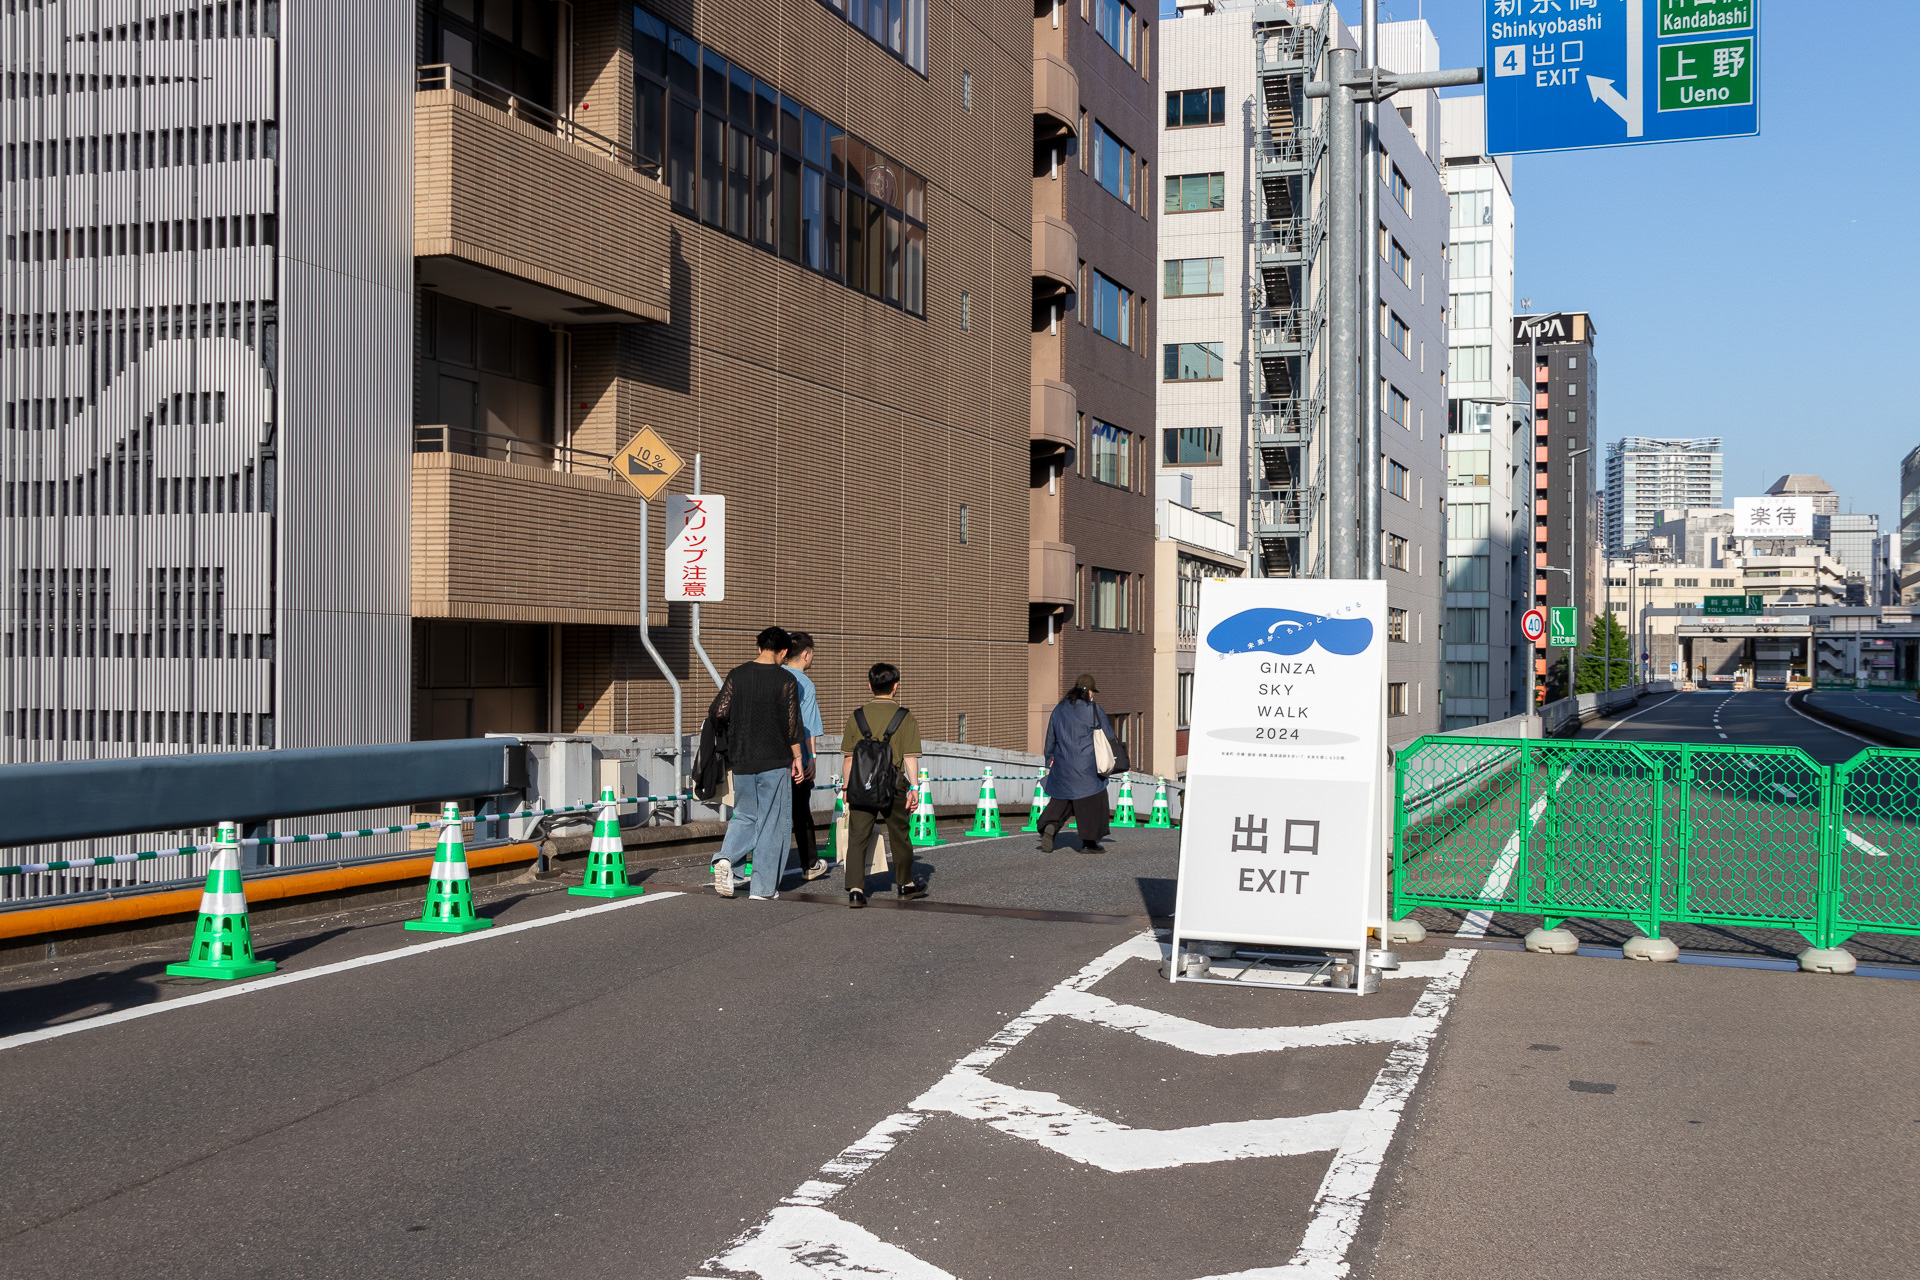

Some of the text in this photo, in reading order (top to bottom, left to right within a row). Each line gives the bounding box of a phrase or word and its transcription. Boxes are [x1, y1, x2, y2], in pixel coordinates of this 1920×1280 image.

[1491, 13, 1602, 40] Shinkyobashi
[1664, 7, 1747, 31] Kandabashi
[1503, 40, 1583, 71] 4 出口
[1665, 46, 1745, 82] 上野
[1536, 67, 1580, 88] EXIT
[1680, 86, 1730, 104] Ueno
[1750, 506, 1796, 526] 楽待
[682, 499, 708, 597] スリップ注意
[1528, 618, 1541, 632] 40
[1260, 661, 1316, 675] GINZA
[1258, 683, 1295, 696] SKY
[1257, 705, 1309, 719] WALK
[1255, 727, 1300, 741] 2024
[1231, 814, 1321, 856] 出口
[1238, 867, 1310, 895] EXIT
